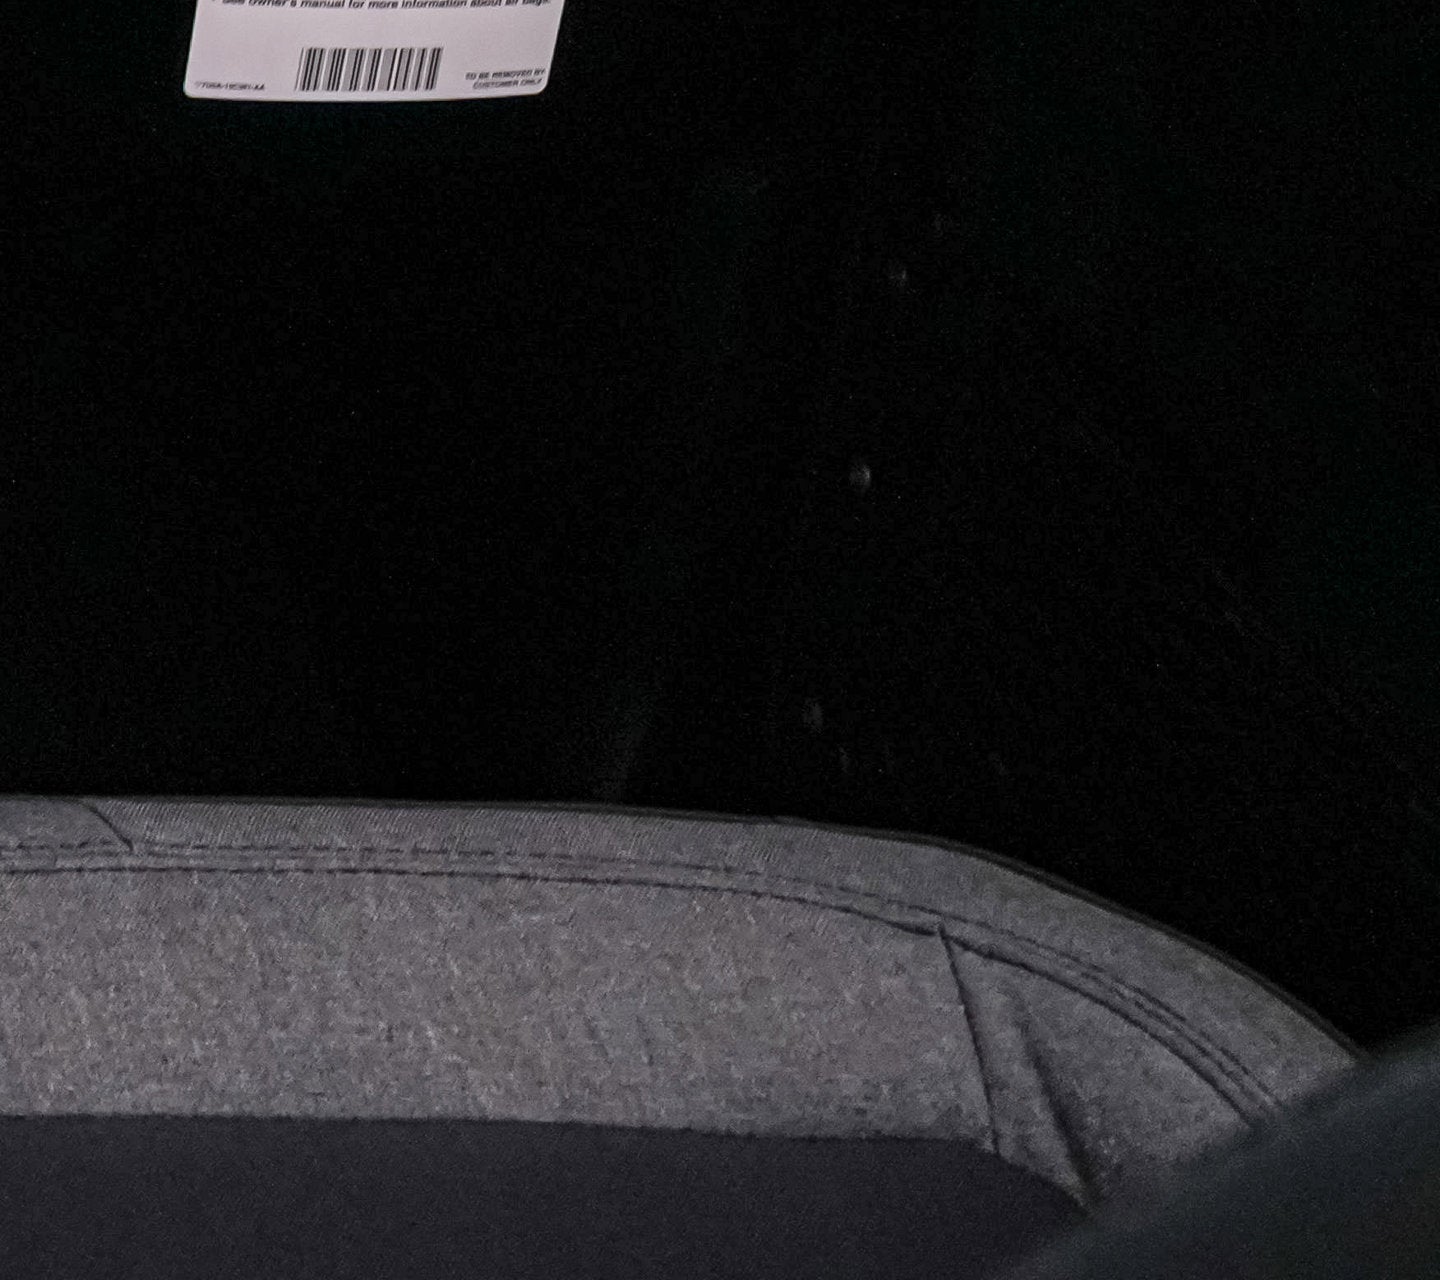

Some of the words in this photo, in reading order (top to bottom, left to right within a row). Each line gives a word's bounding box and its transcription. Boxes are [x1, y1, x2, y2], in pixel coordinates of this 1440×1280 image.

[300, 0, 345, 8] manual
[348, 0, 365, 8] for
[368, 0, 398, 8] more
[401, 0, 467, 9] information
